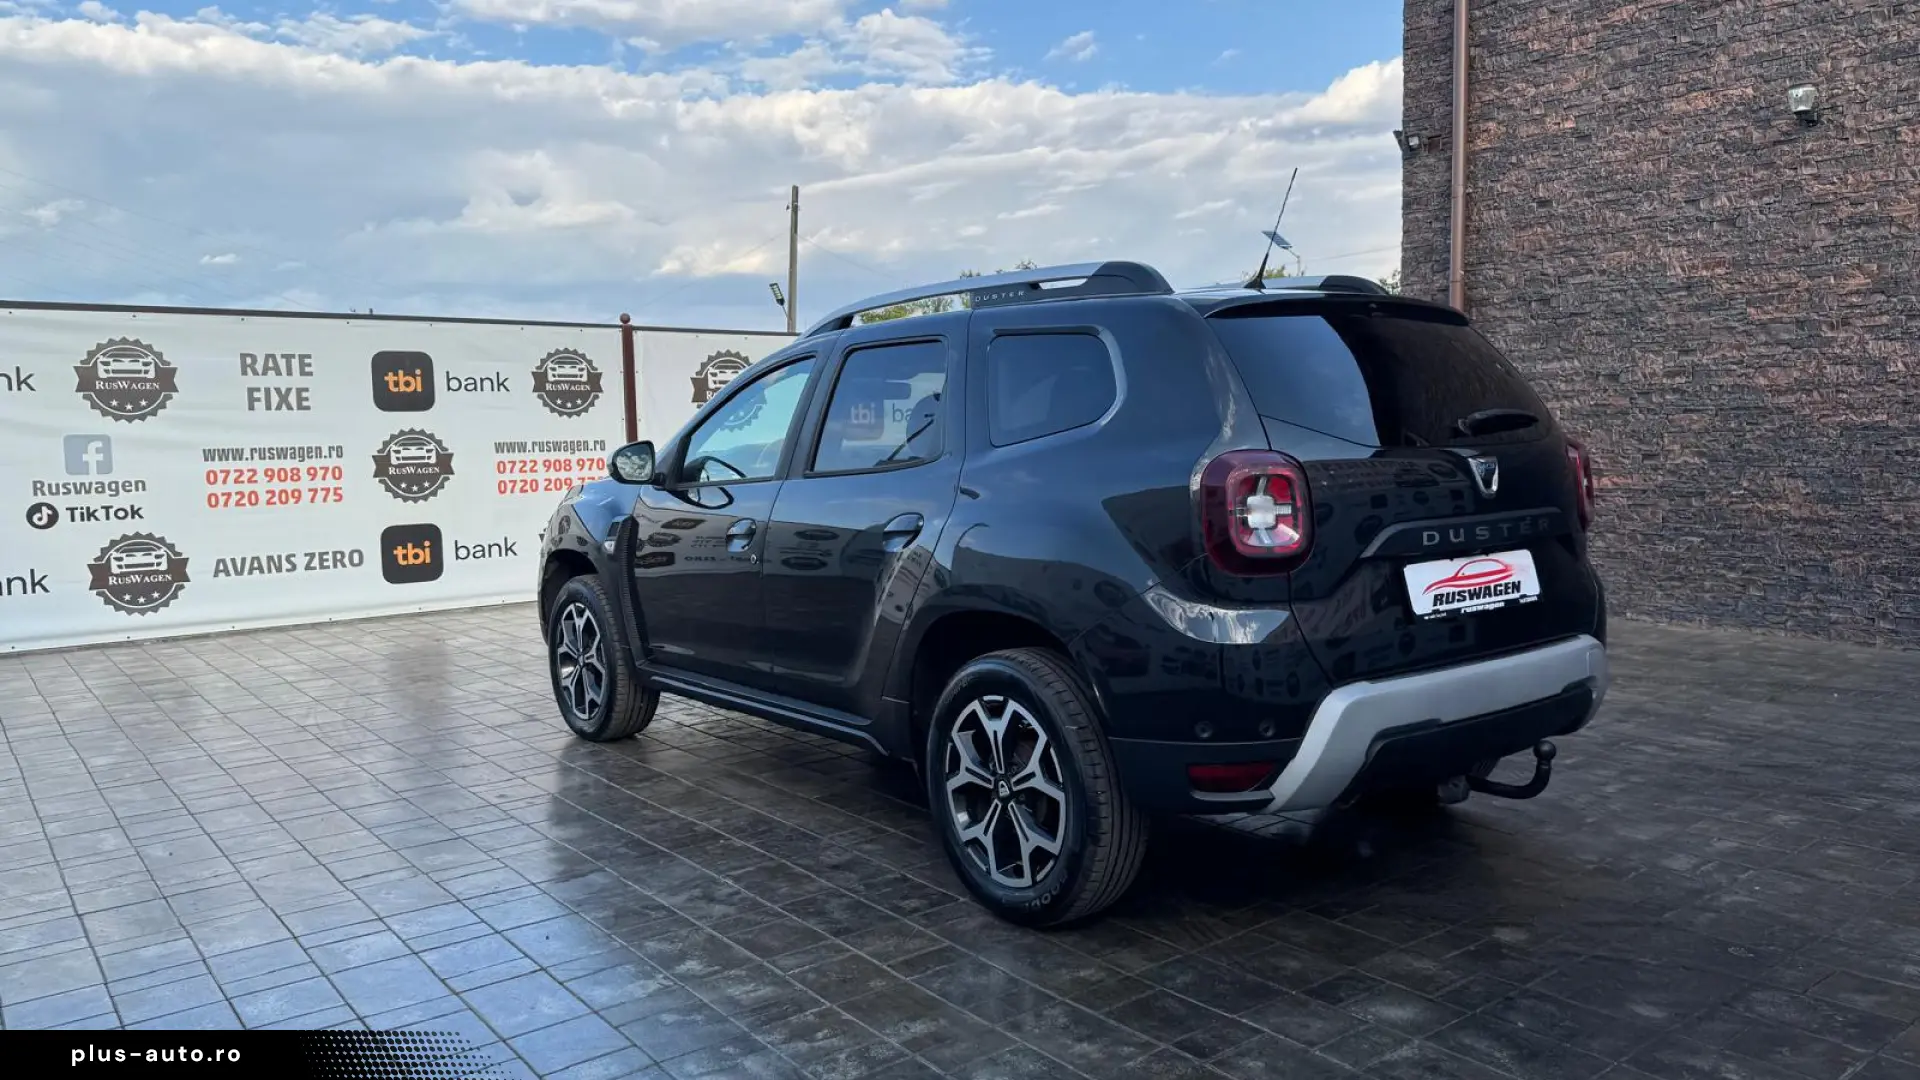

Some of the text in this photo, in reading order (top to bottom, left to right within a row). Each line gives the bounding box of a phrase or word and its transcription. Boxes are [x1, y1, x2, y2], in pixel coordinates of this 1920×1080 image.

[240, 353, 314, 377] RATE
[384, 368, 511, 393] tbi bank
[247, 387, 312, 411] FIXE
[851, 402, 876, 424] tbi
[202, 445, 344, 462] www.ruswagen.ro
[494, 440, 606, 454] www.ruswagen.ro
[205, 465, 343, 485] 0722 908 970
[496, 458, 606, 474] 0722 908 970
[32, 479, 147, 498] Ruswagen
[497, 480, 540, 494] 0720
[544, 477, 573, 492] 209
[207, 487, 344, 508] 0720 209 775
[65, 504, 145, 523] TikTok
[1422, 518, 1550, 546] DUSTER
[393, 537, 518, 566] tbi bank
[213, 549, 364, 577] AVANS ZERO
[0, 568, 51, 596] nk
[1432, 580, 1521, 607] RUSWAGEN
